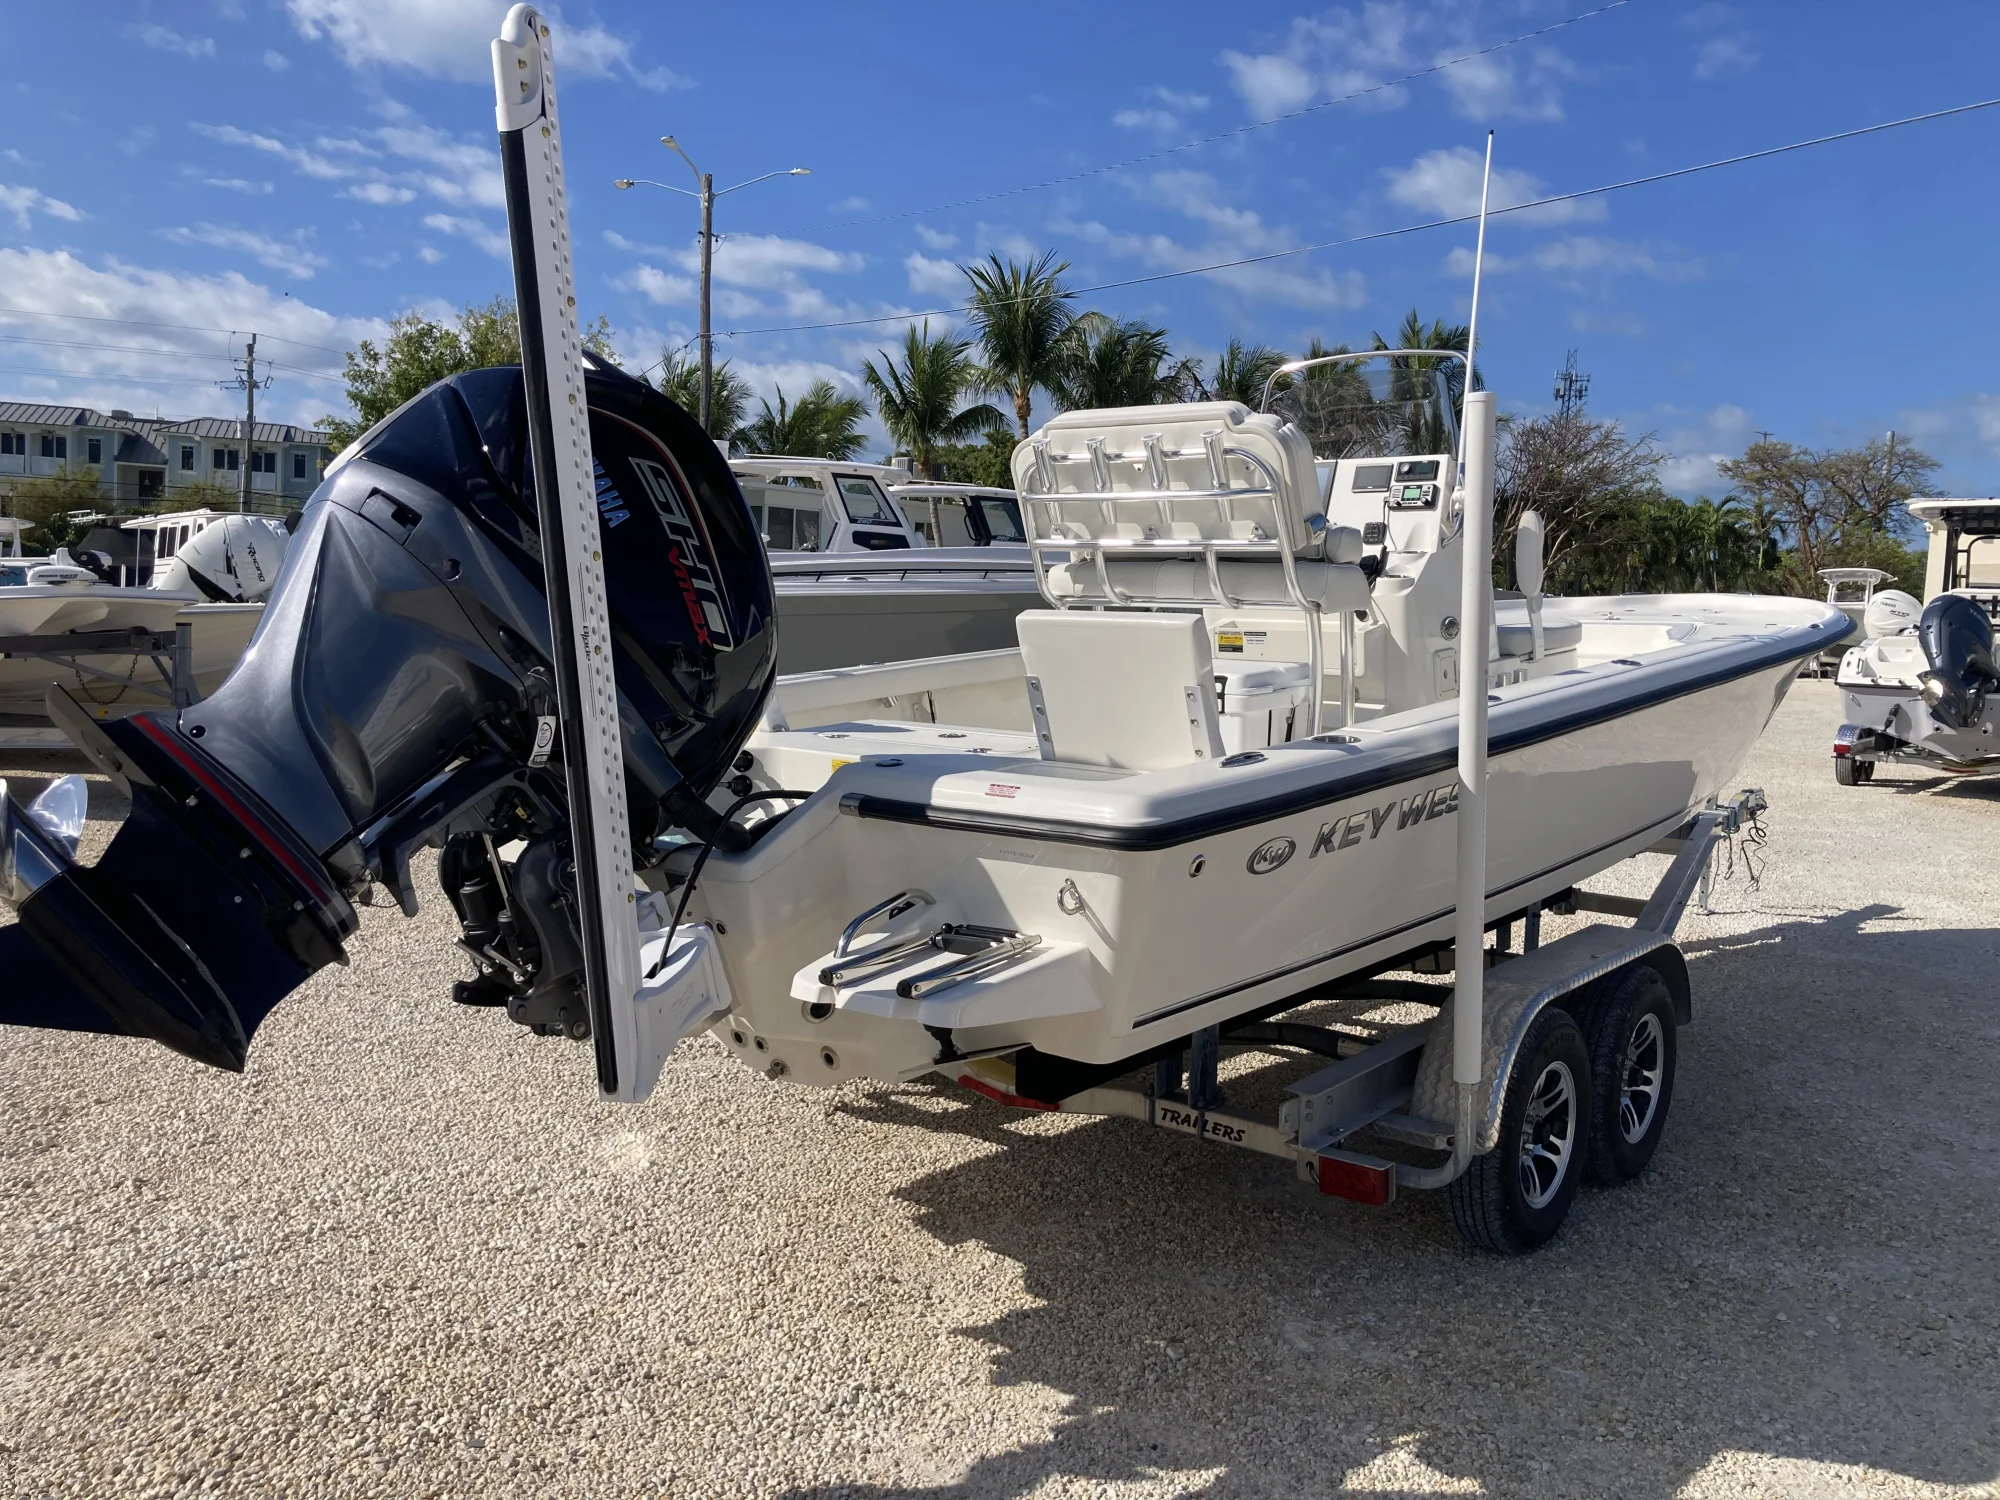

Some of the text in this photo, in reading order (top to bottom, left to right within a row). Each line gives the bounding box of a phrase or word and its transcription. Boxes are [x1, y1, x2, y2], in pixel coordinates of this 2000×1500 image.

[247, 543, 266, 582] Racing
[580, 625, 592, 662] Blade
[1309, 782, 1459, 859] KEY WES
[1161, 1107, 1246, 1142] TRAILERS
